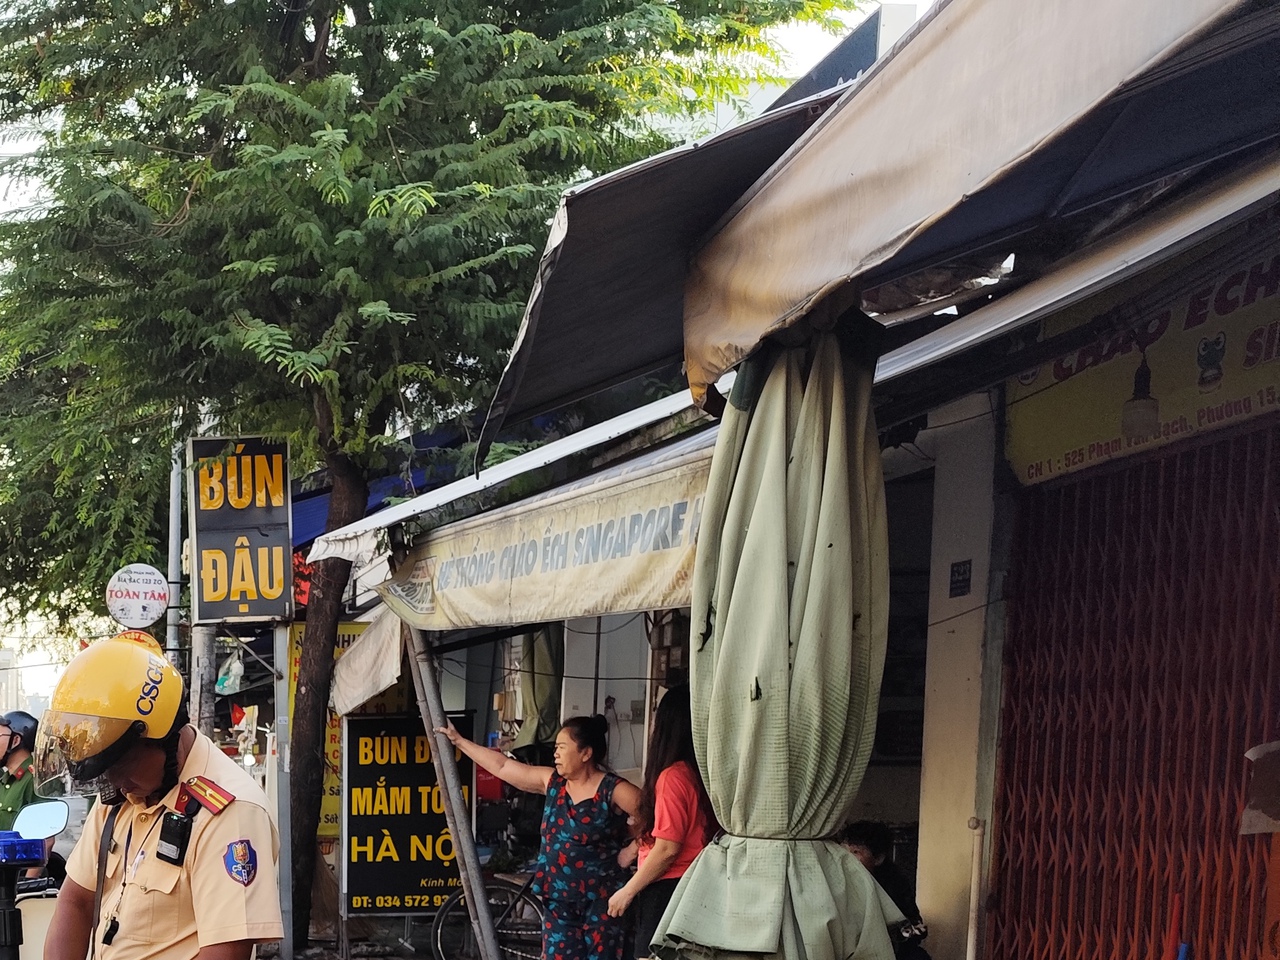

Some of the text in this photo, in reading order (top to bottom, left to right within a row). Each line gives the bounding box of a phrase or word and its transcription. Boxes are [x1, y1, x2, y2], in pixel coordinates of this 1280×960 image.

[1064, 447, 1084, 468] 525
[198, 443, 284, 511] BÚN
[572, 500, 689, 567] SINGAPORE
[142, 577, 152, 585] 123
[200, 535, 284, 613] ĐẬU
[108, 587, 167, 603] TOÀN TÂM
[358, 730, 407, 766] BÚN
[351, 776, 411, 816] MẮM
[350, 828, 400, 863] HÀ
[420, 877, 445, 888] Kính
[352, 895, 372, 908] ĐT:
[375, 895, 401, 908] 034
[404, 895, 430, 908] 572
